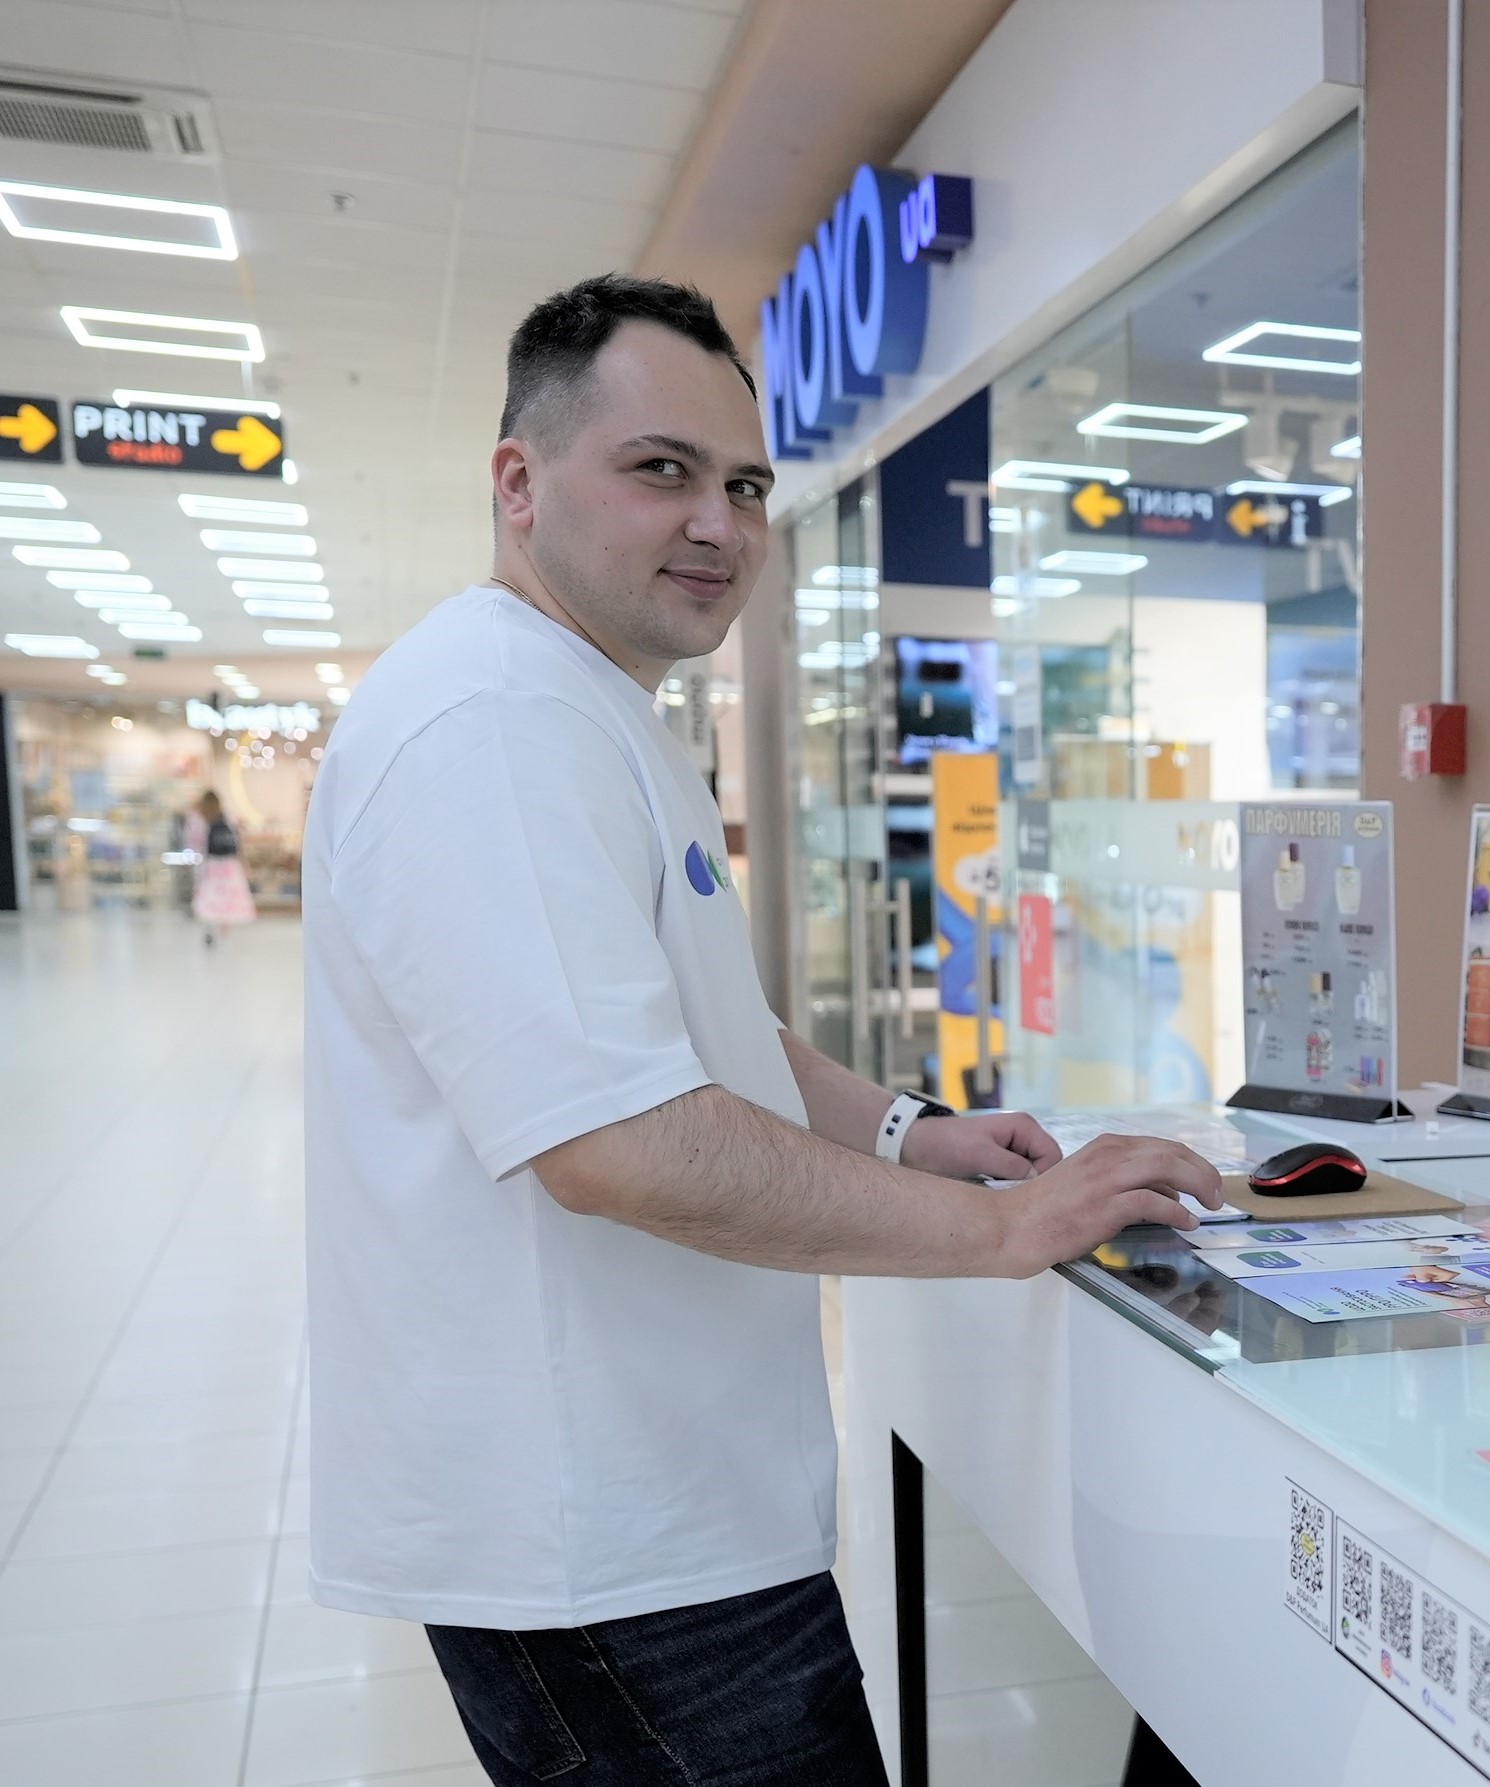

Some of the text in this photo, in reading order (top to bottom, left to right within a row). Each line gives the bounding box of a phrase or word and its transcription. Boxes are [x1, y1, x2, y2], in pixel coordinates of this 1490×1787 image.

[760, 163, 886, 461] MOYO
[73, 404, 206, 447] PRINT
[1246, 808, 1342, 838] ПАРФУМЕРІЯ
